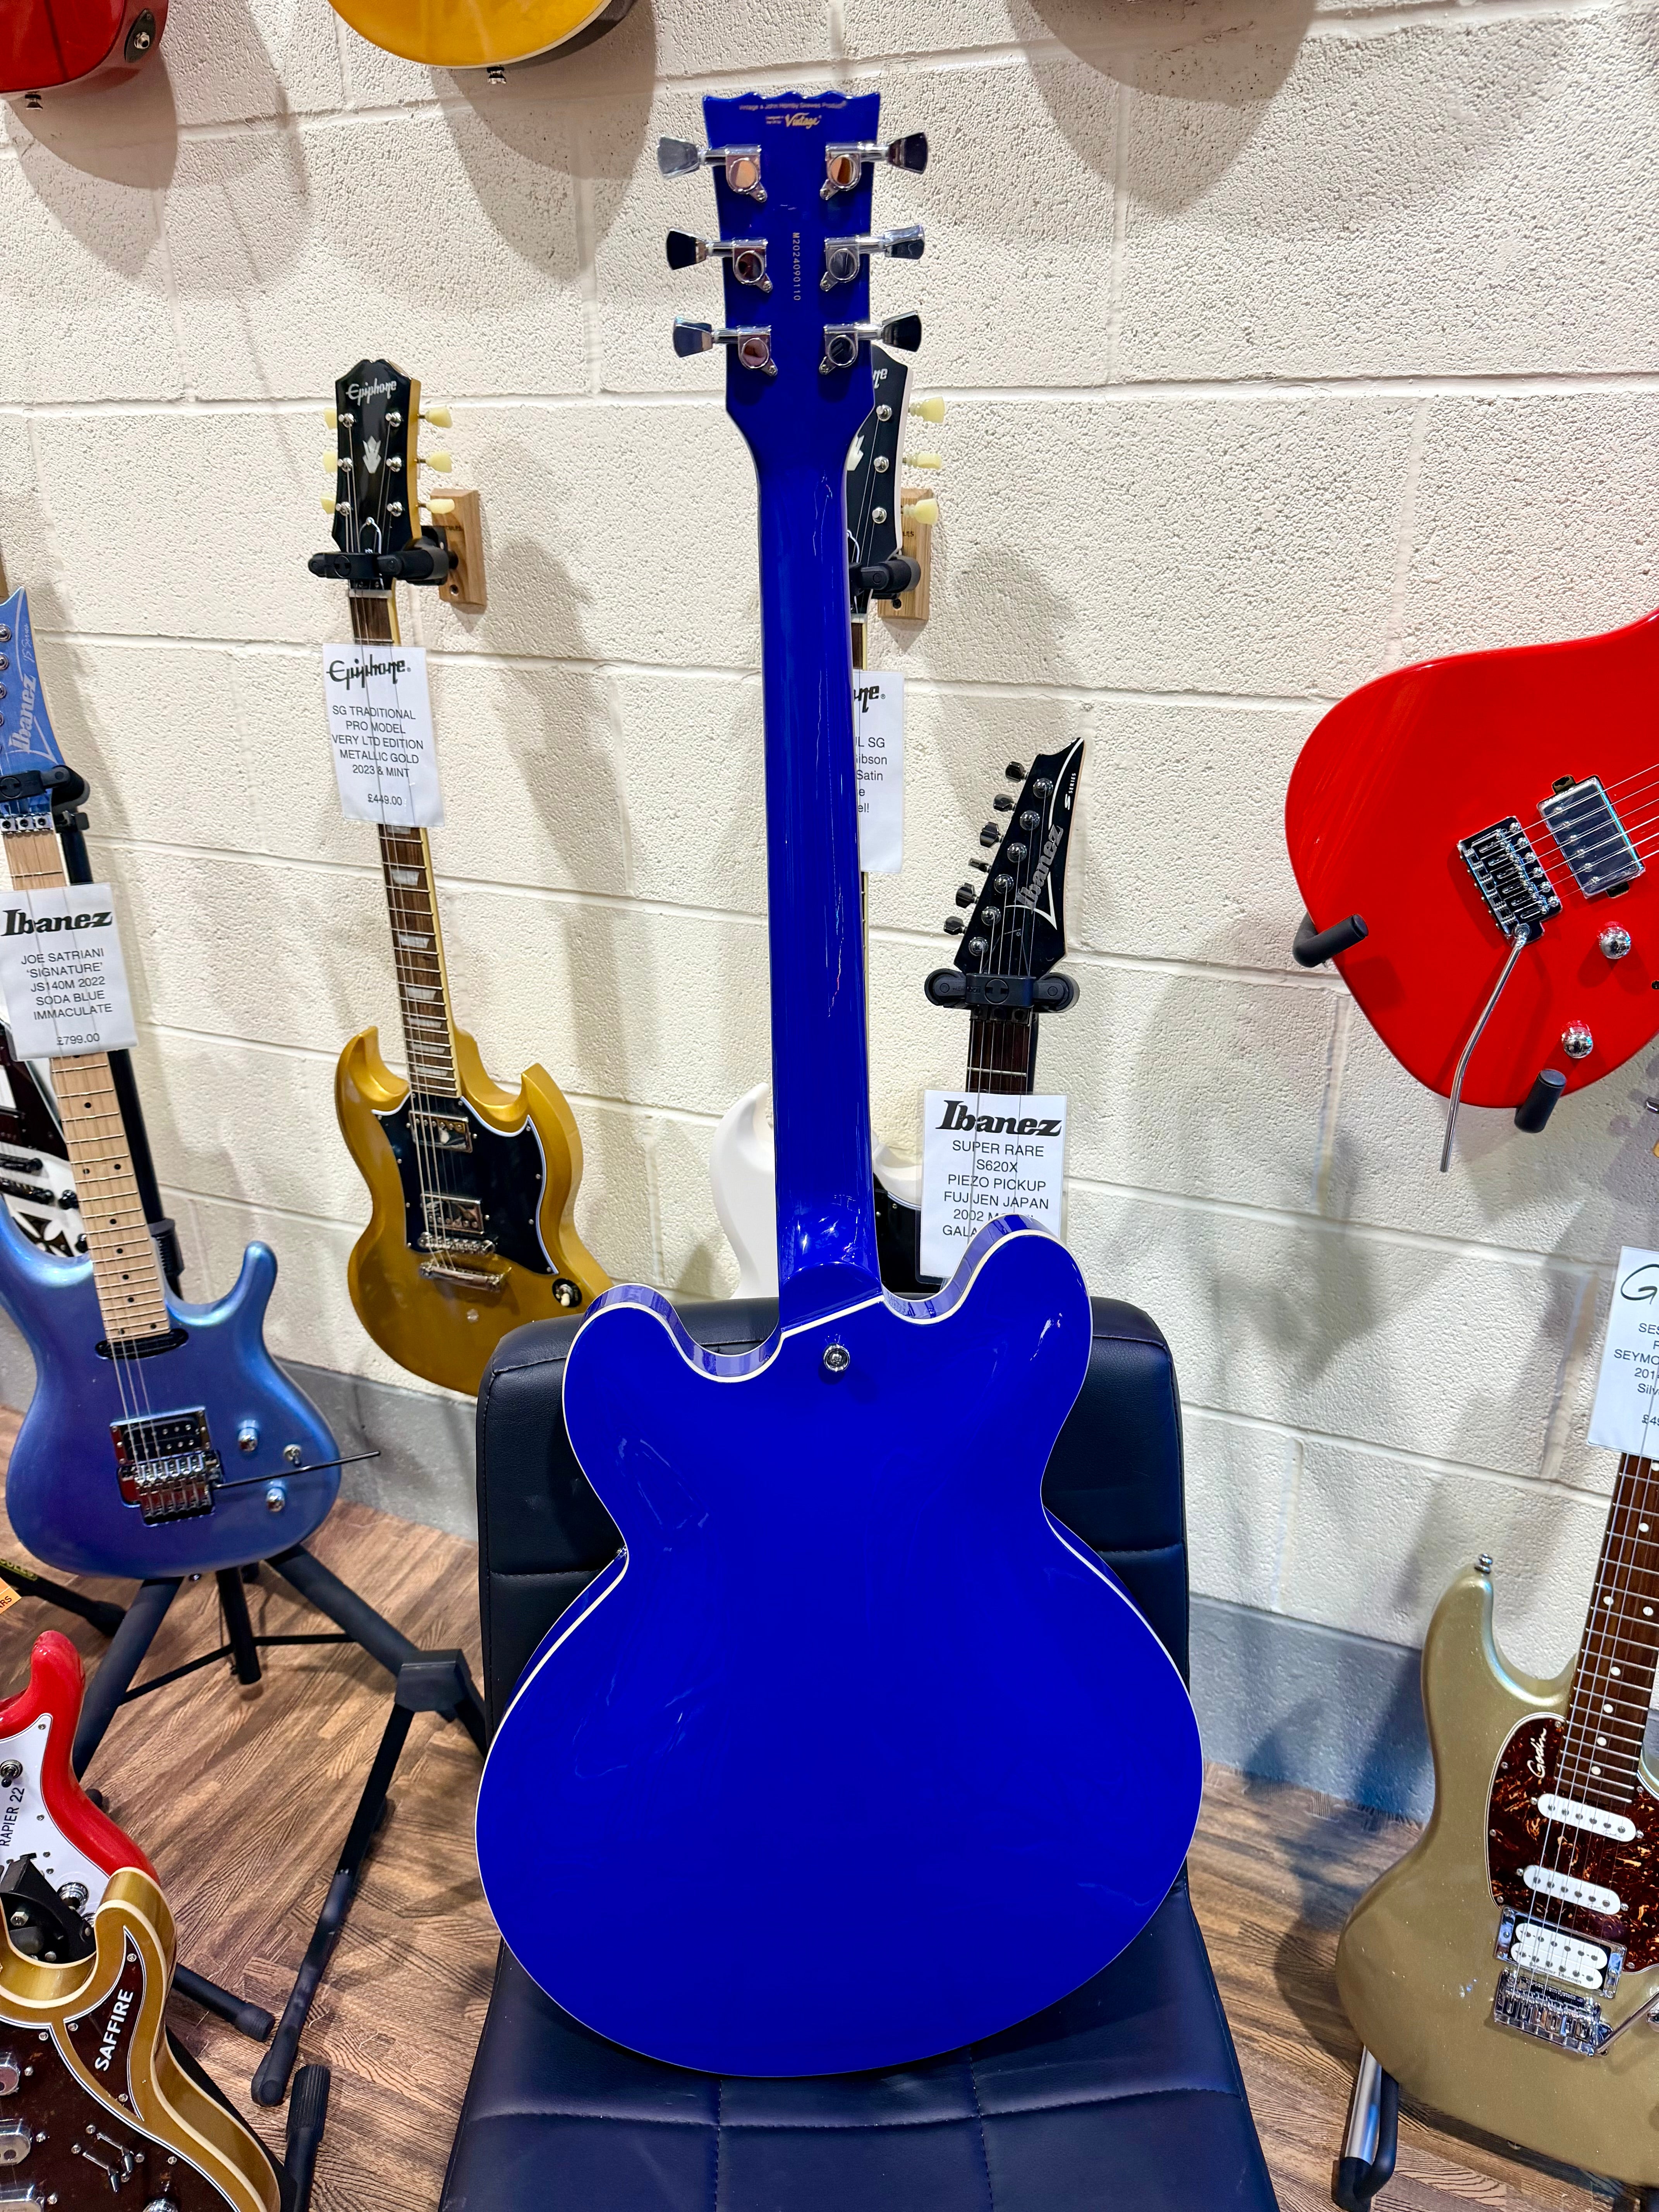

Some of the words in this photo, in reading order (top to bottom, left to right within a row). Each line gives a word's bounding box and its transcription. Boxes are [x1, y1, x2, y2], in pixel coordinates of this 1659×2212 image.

[785, 112, 820, 129] Vintage
[793, 232, 801, 301] M2024090110
[346, 378, 397, 405] Epiphone
[326, 654, 405, 690] Epiphone
[9, 673, 36, 754] Ibanez
[333, 706, 347, 715] SG
[349, 706, 416, 720] TRADITIONAL
[346, 721, 368, 731] PRO
[371, 722, 405, 734] MODEL
[331, 734, 358, 745] VERY
[362, 736, 380, 746] LTD
[384, 738, 423, 749] EDITION
[868, 737, 885, 748] SG
[340, 749, 388, 761] METALLIC
[391, 753, 419, 764] GOLD
[856, 754, 887, 765] ibson
[353, 765, 375, 775] 2023
[377, 766, 383, 775] &
[386, 767, 410, 778] MINT
[857, 769, 883, 781] Satin
[368, 794, 402, 805] £449.00
[1015, 824, 1063, 914] Ibanez
[0, 908, 112, 936] Ibanez
[21, 954, 45, 965] JOE
[48, 948, 105, 962] SATRIANI
[31, 980, 75, 993] JS140M
[79, 976, 105, 988] 2022
[36, 994, 70, 1006] SODA
[74, 990, 105, 1001] BLUE
[34, 1003, 112, 1020] IMMACULATE
[57, 1033, 100, 1045] £799.00
[935, 1100, 1062, 1137] Ibanez
[952, 1140, 1000, 1154] SUPER
[1005, 1144, 1044, 1157] RARE
[976, 1159, 1018, 1173] S620X
[948, 1175, 989, 1188] PIEZO
[994, 1178, 1046, 1192] PICKUP
[945, 1191, 998, 1206] FUJJEN
[1003, 1197, 1049, 1209] JAPAN
[953, 1209, 984, 1221] 2002
[1634, 1367, 1659, 1379] 201
[1637, 1383, 1659, 1395] Silv
[1527, 1728, 1547, 1778] Godin
[9, 1787, 25, 1802] 22
[0, 1807, 19, 1846] RAPIER
[94, 1989, 134, 2071] SAFFIRE
